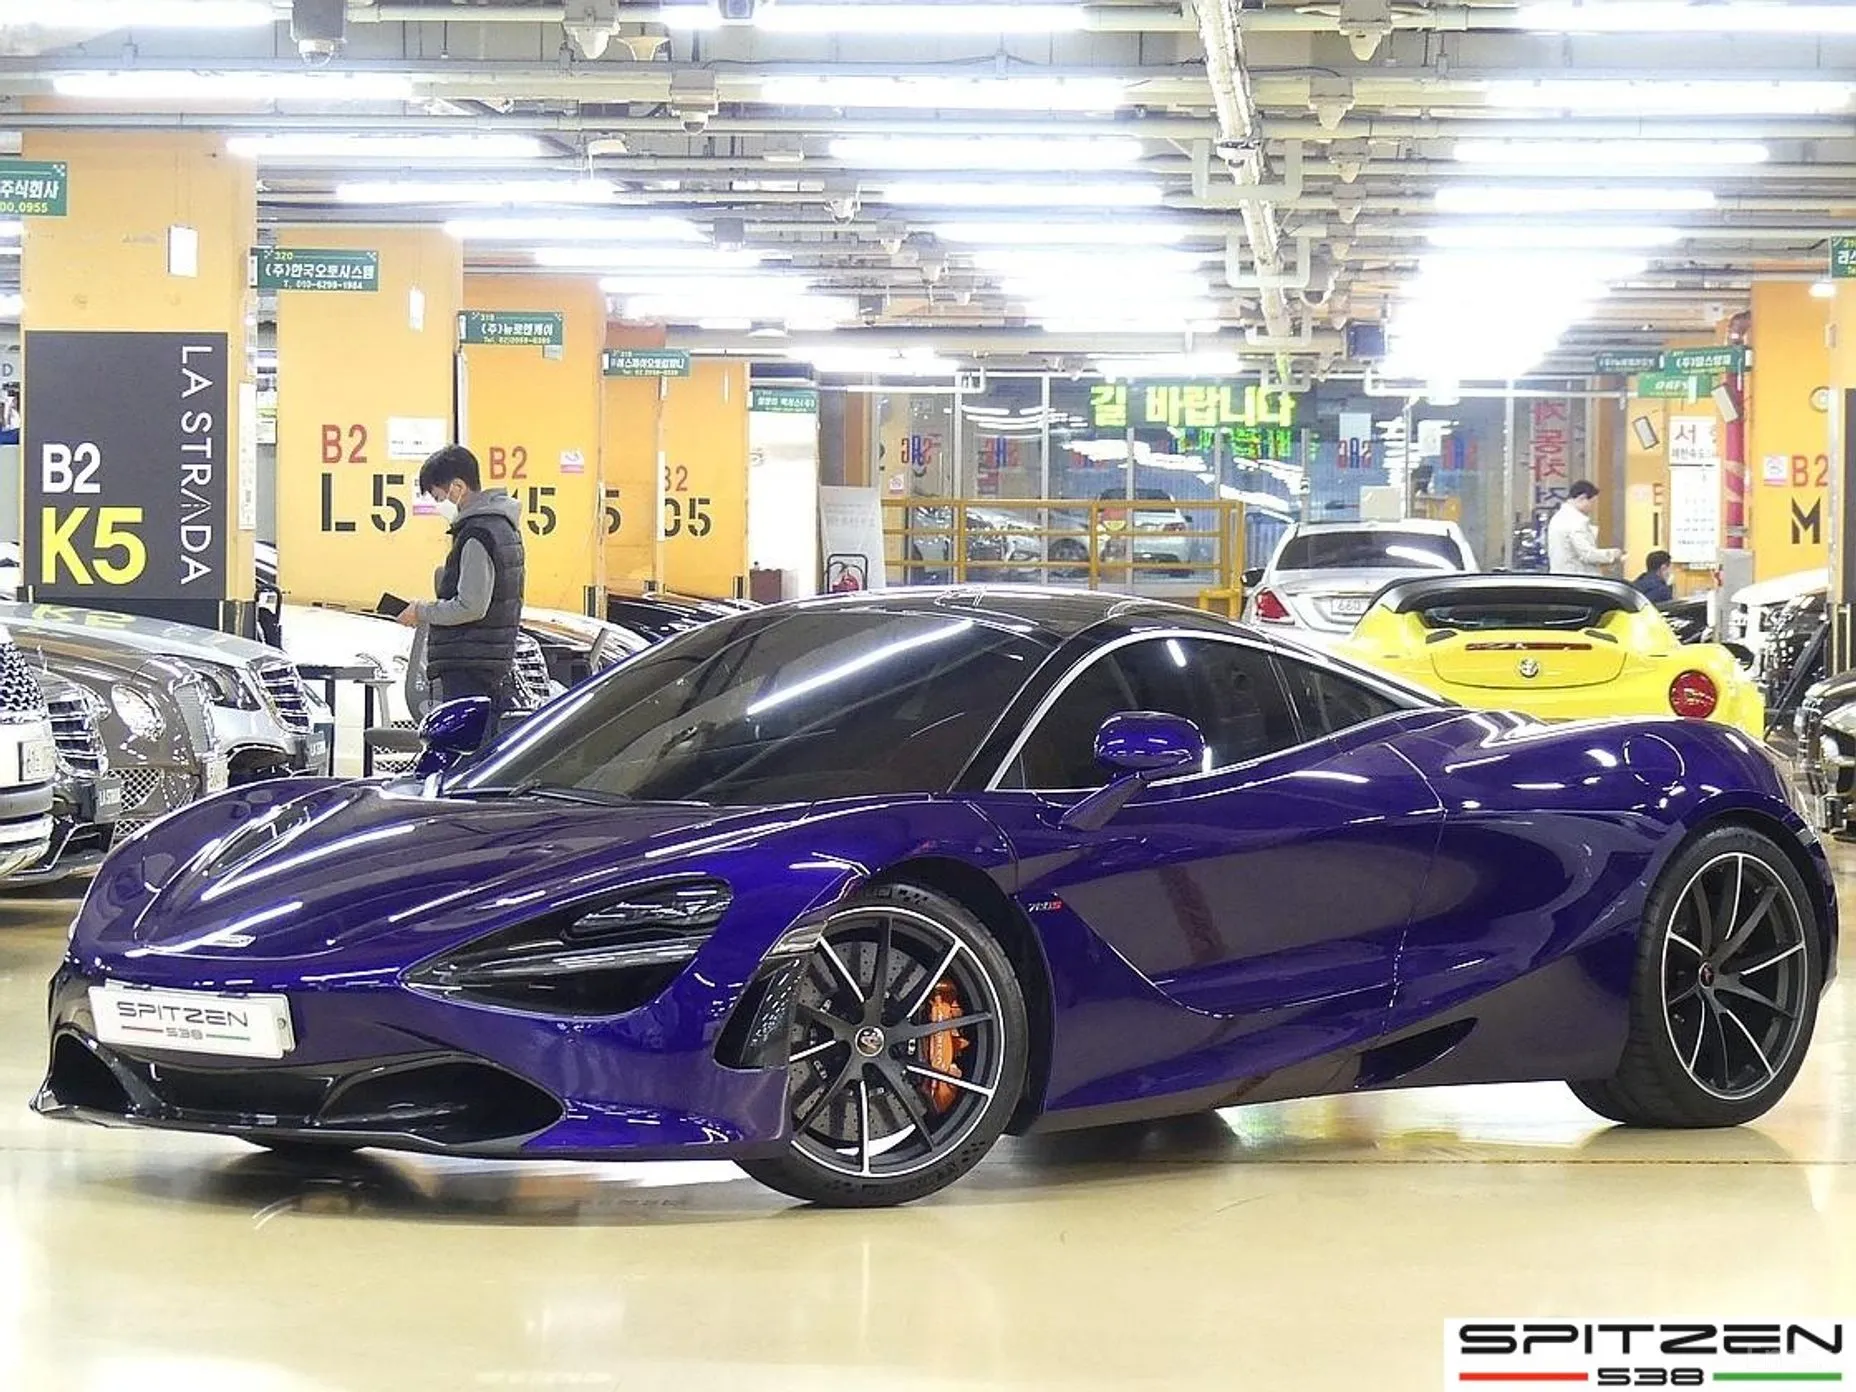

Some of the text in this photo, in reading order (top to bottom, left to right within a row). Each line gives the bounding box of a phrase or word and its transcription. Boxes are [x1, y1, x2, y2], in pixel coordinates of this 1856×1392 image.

[1, 180, 60, 199] 주식회사
[181, 346, 213, 398] LA
[1145, 384, 1297, 427] 바랍니다
[322, 424, 368, 464] B2
[489, 446, 528, 480] B2
[42, 442, 101, 494] B2
[1792, 455, 1828, 487] B2
[180, 410, 213, 585] STRADA
[321, 472, 407, 533] L5
[42, 506, 149, 586] K5
[116, 1001, 249, 1027] SPITZEN
